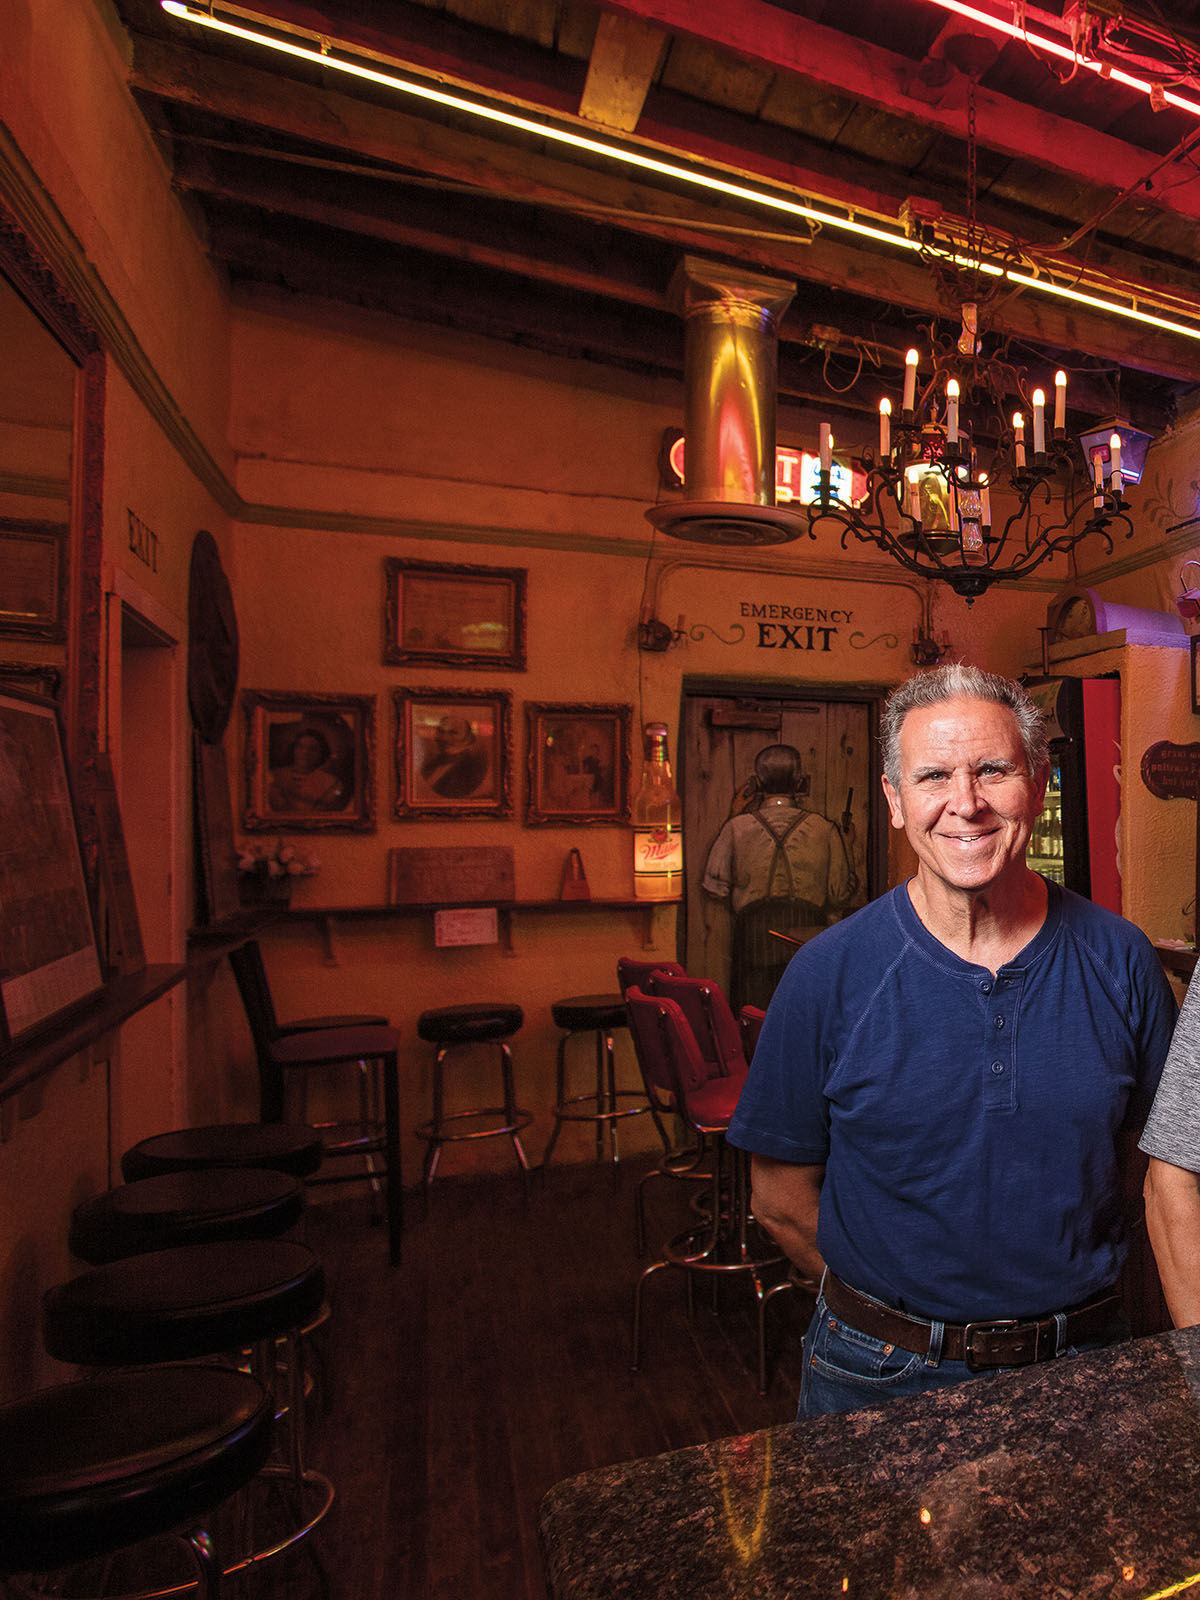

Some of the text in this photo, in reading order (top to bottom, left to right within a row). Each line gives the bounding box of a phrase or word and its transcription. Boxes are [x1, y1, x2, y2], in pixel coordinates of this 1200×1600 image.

[125, 506, 159, 575] EXIT
[739, 602, 854, 624] EMERGENCY
[756, 622, 839, 652] EXIT
[639, 842, 680, 860] Miller
